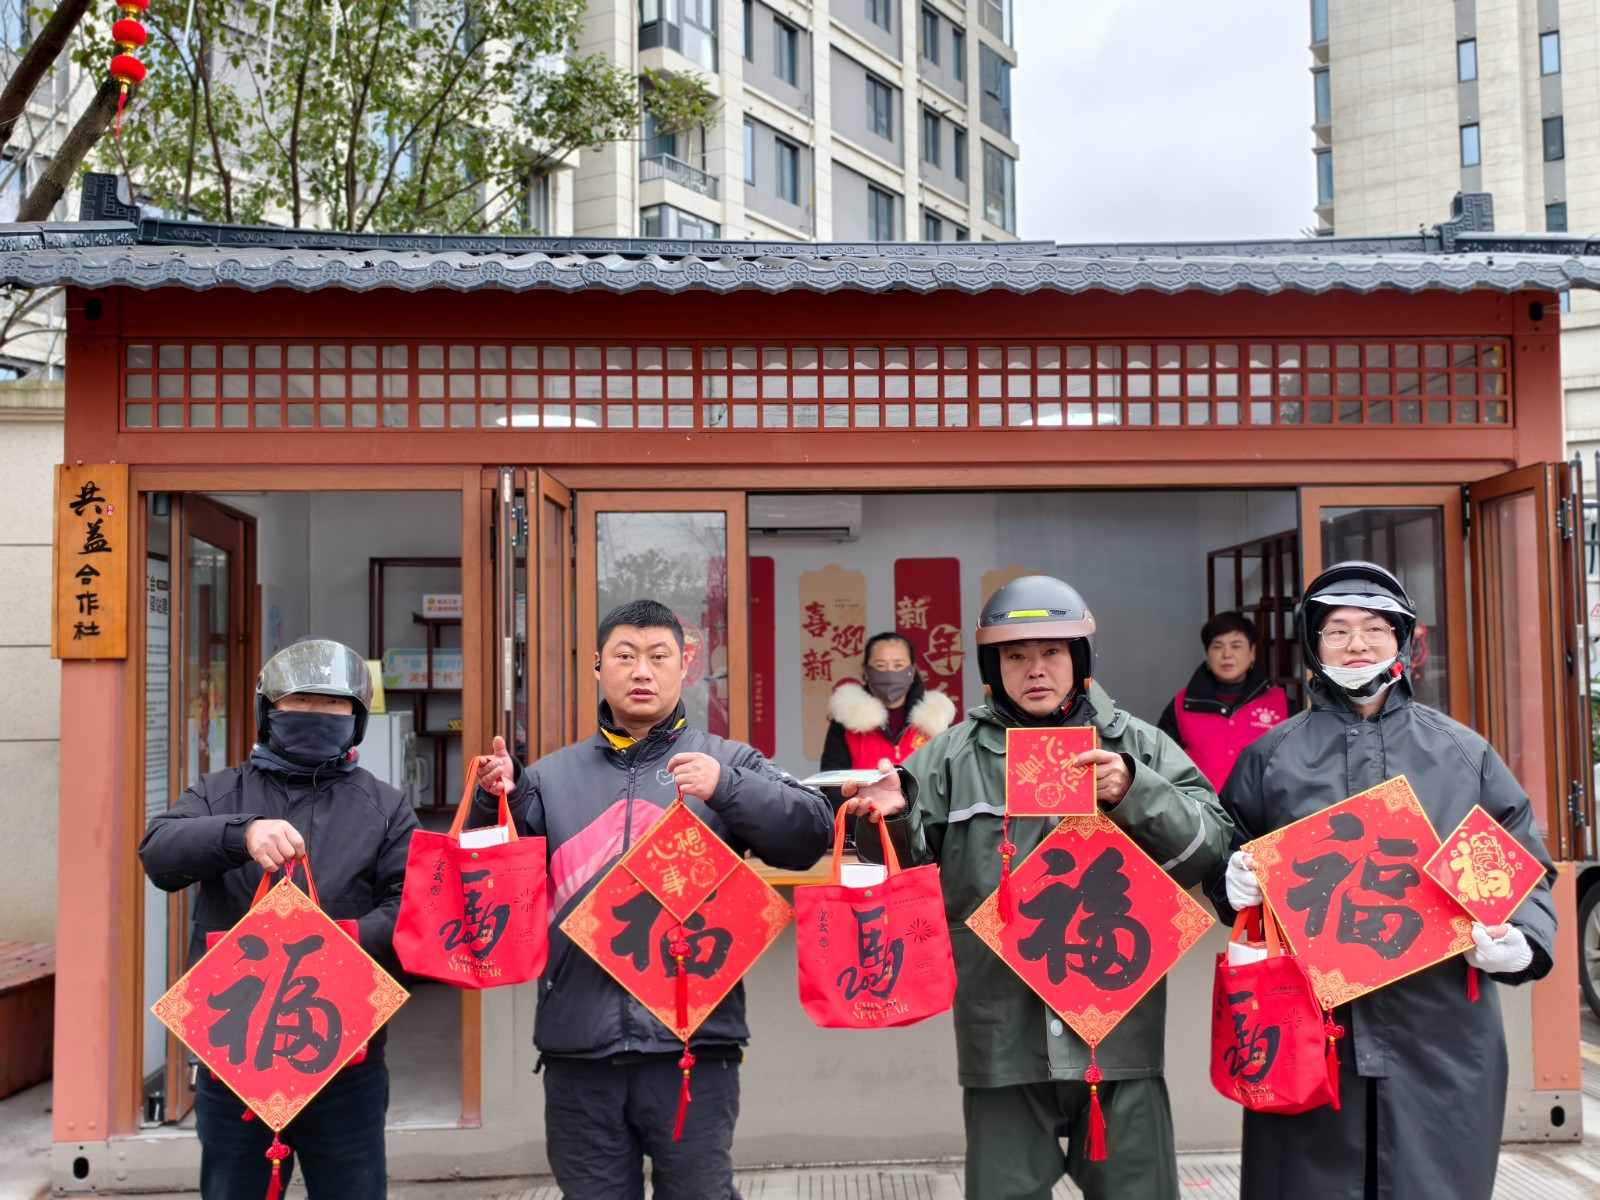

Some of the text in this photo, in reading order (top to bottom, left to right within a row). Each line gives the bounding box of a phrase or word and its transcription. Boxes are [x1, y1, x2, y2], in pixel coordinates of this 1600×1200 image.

[70, 481, 112, 640] 共益合作社
[1017, 847, 1151, 991] 福
[1285, 812, 1424, 961] 福
[207, 934, 342, 1074] 福
